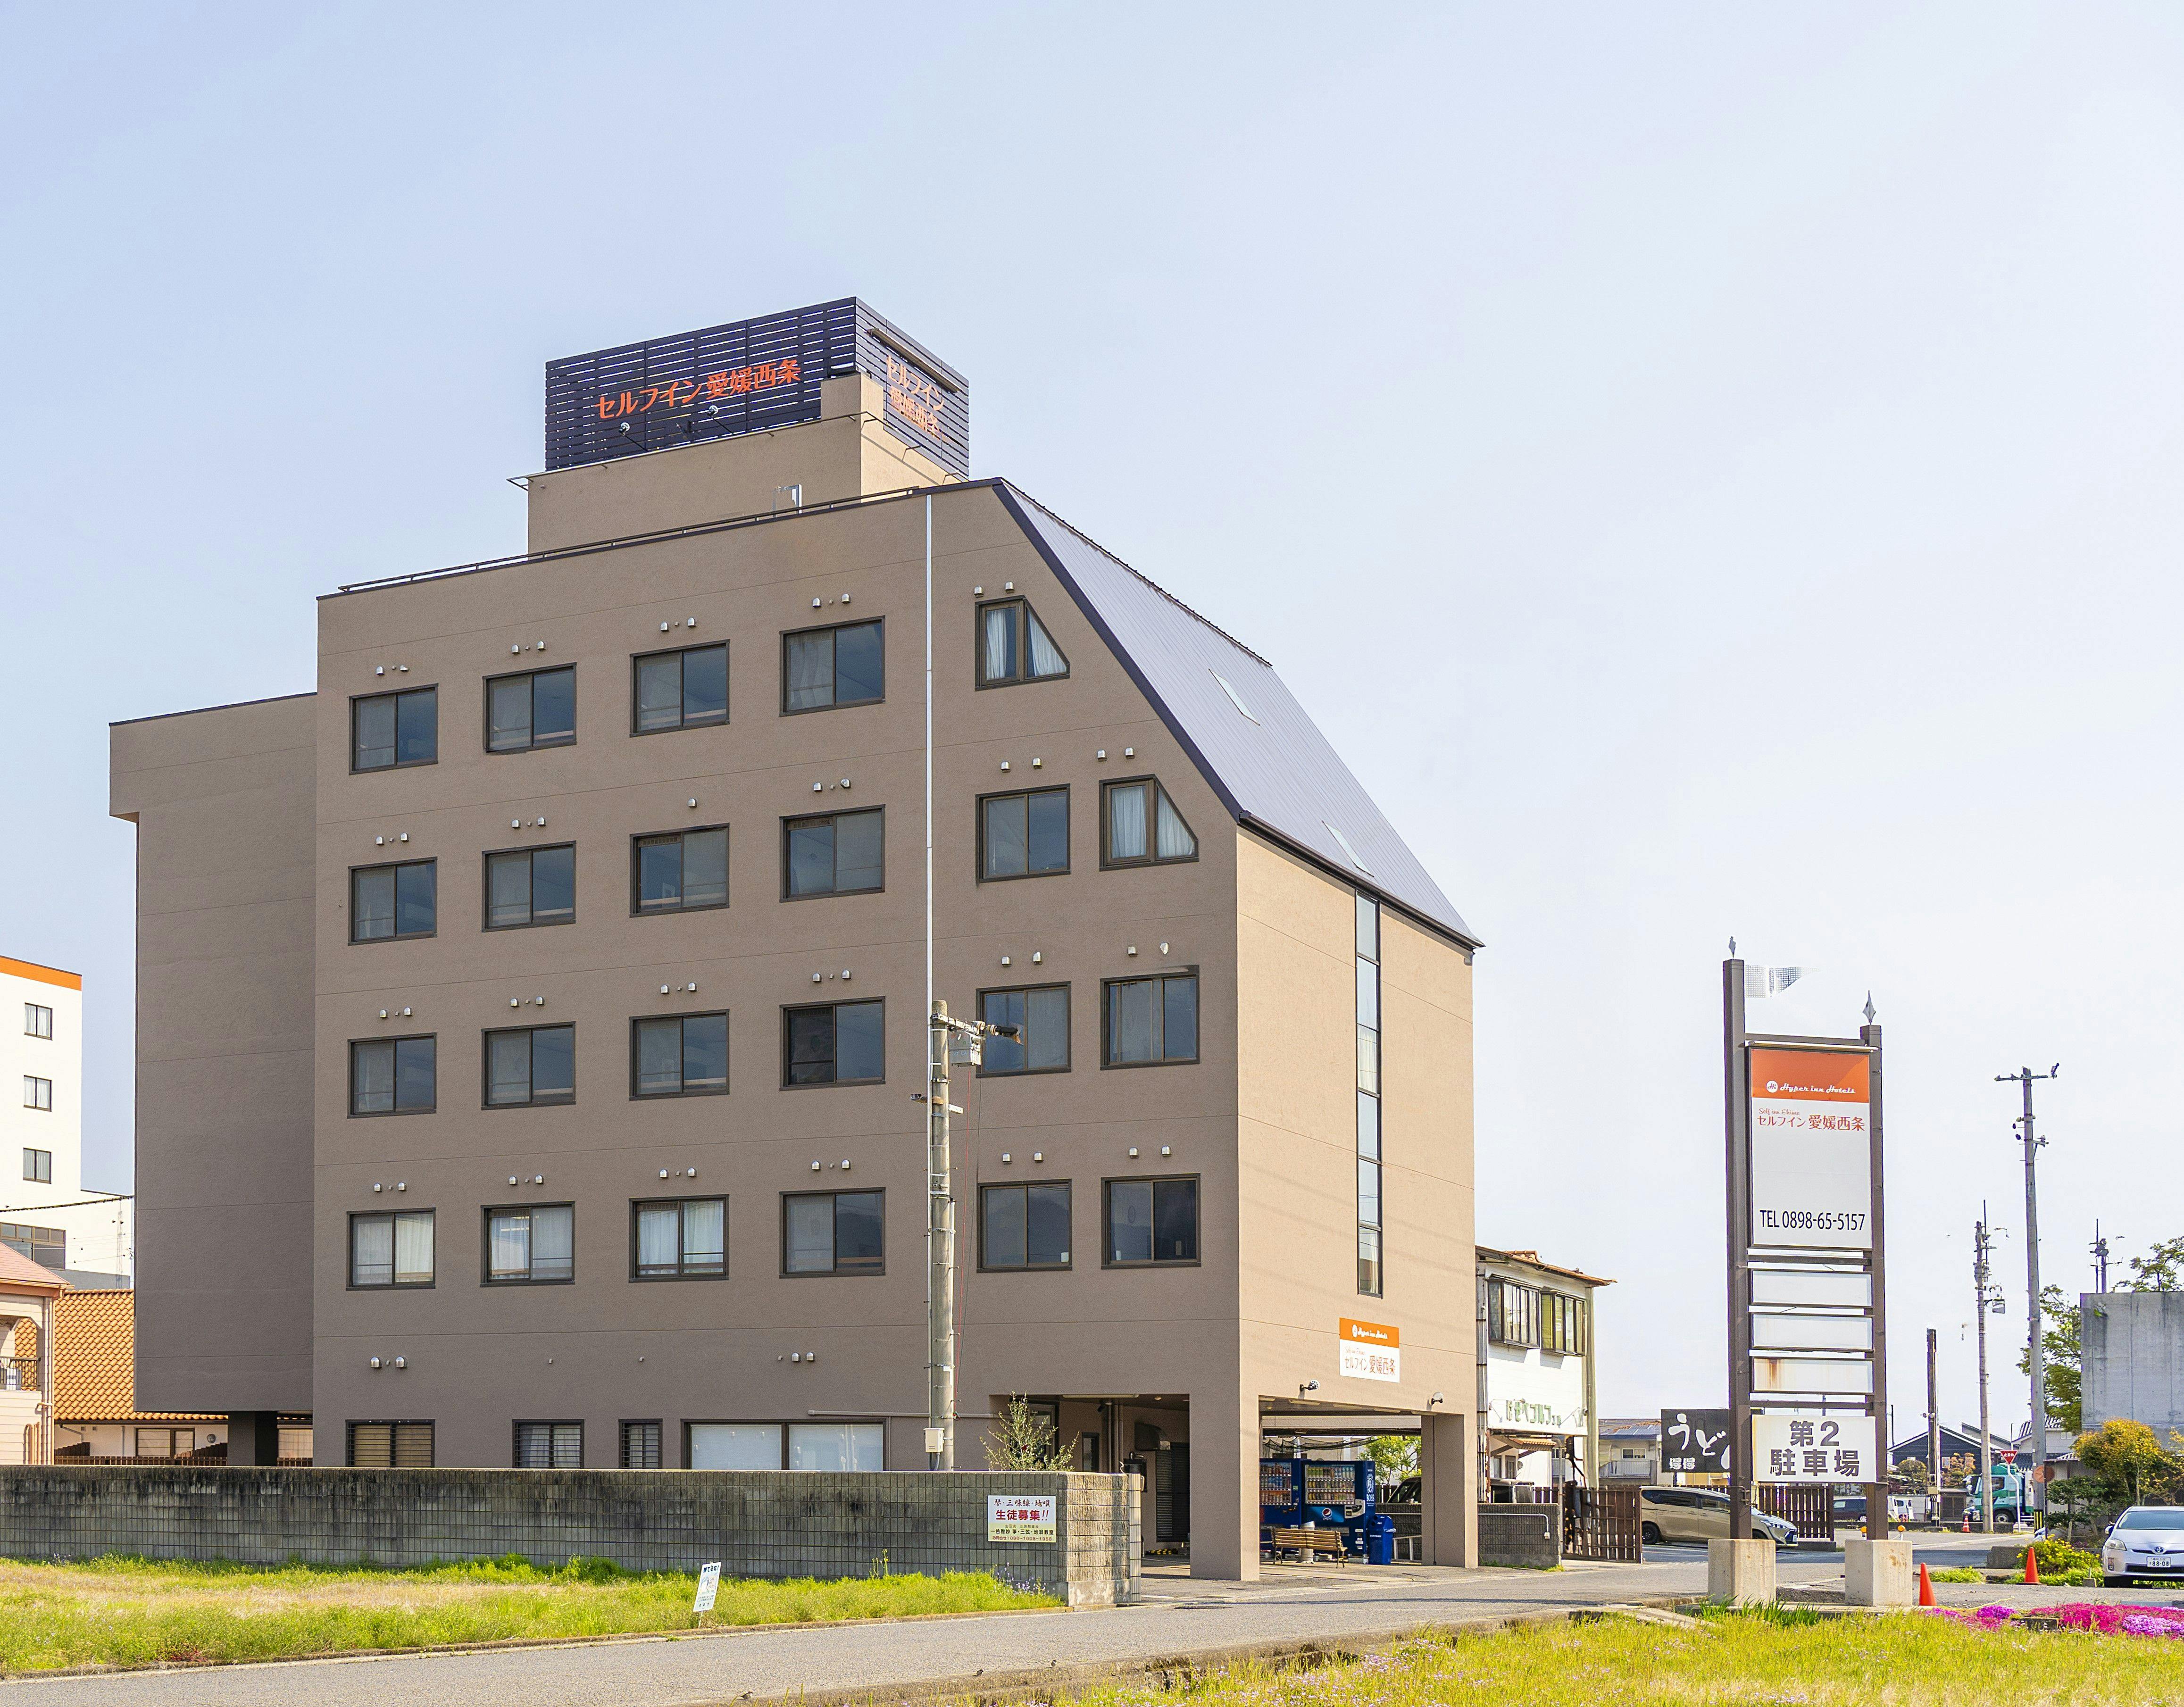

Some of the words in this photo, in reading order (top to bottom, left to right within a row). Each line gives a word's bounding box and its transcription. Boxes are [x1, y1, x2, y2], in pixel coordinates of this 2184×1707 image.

[887, 356, 944, 411] セルフイン
[1780, 1083, 1809, 1093] Hyper
[1826, 1085, 1856, 1094] Hotels
[1760, 1210, 1779, 1228] TEL
[1782, 1211, 1865, 1231] 0898-65-5157
[1790, 1420, 1840, 1448] 第2
[1770, 1448, 1859, 1477] 駐車場
[1366, 1494, 1375, 1502] BOSS
[996, 1509, 1049, 1521] 生徒募集!!
